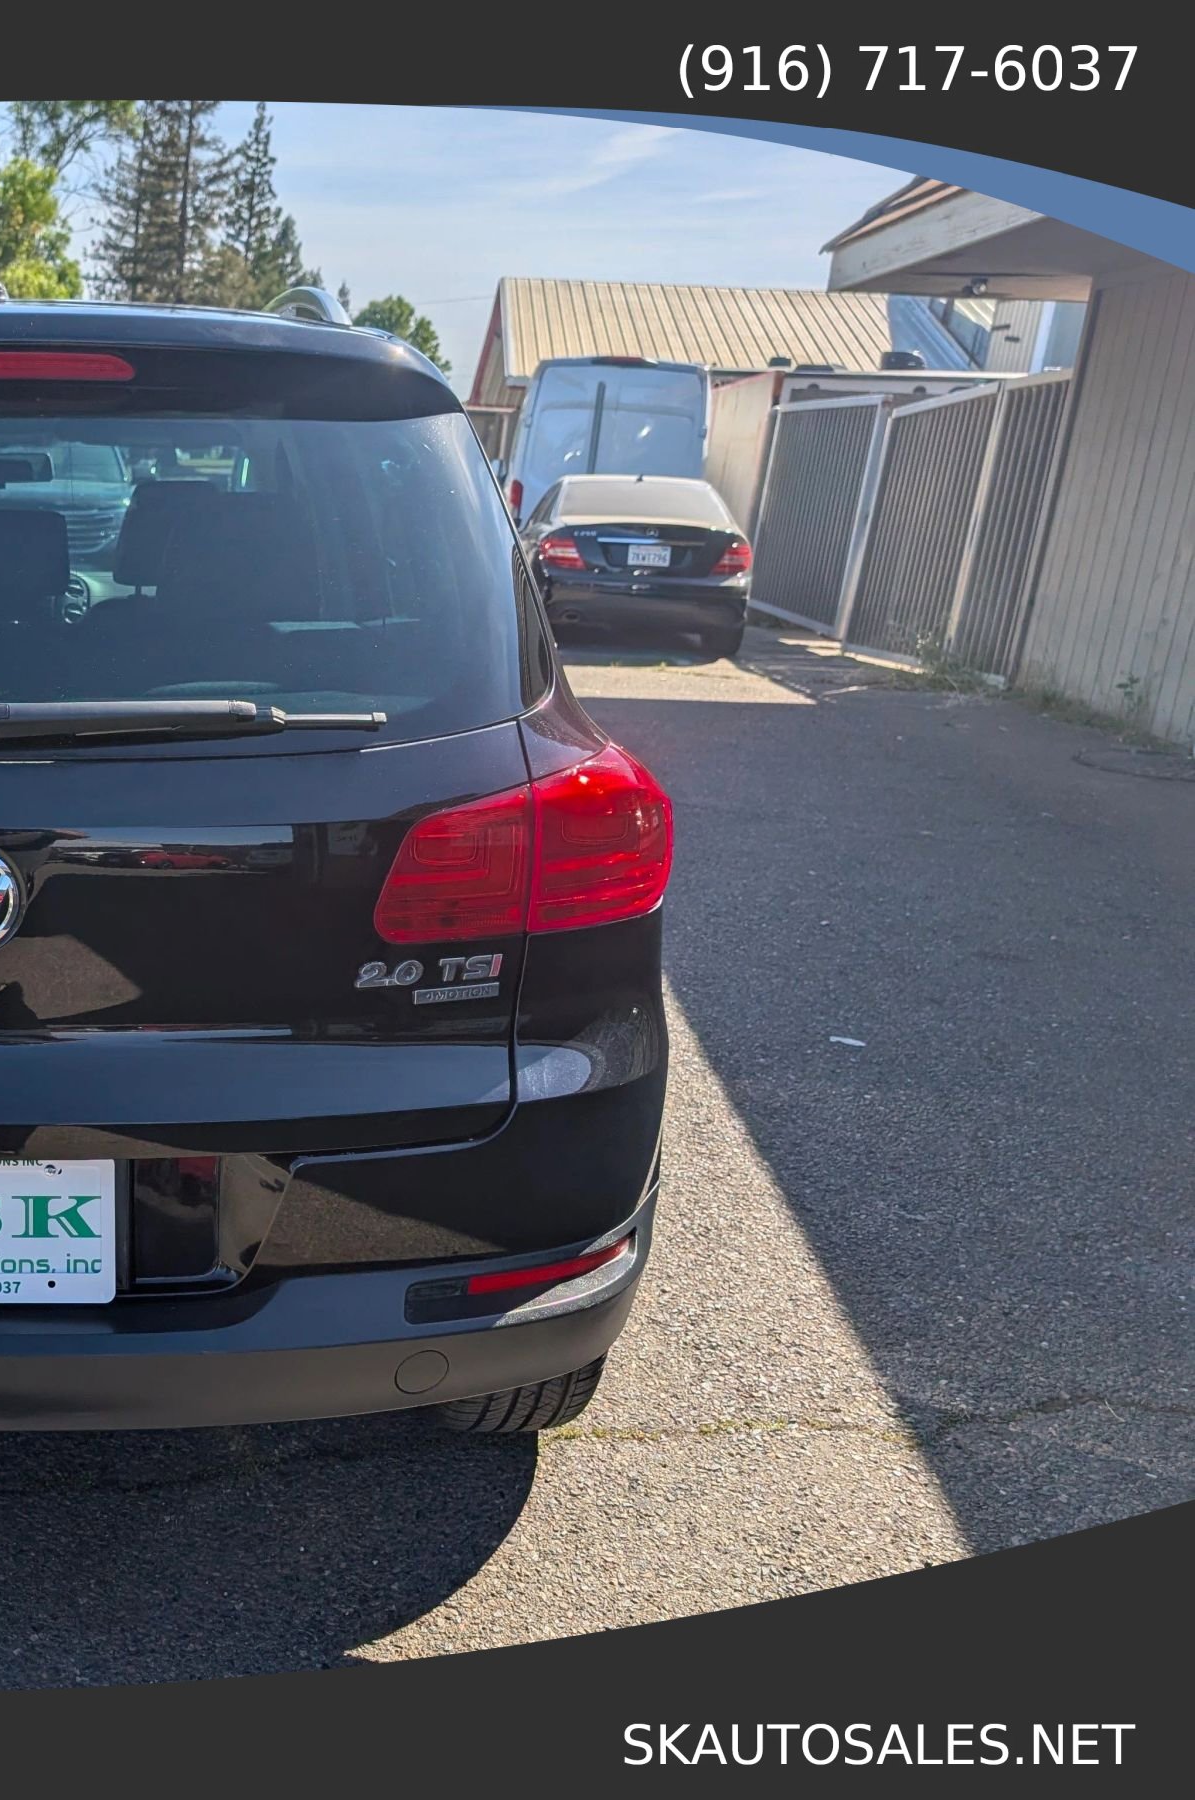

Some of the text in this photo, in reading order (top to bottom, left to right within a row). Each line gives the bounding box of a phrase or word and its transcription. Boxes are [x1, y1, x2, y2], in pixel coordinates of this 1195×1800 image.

[355, 953, 503, 988] 2.0 TSI
[21, 1158, 44, 1168] INC
[65, 1253, 103, 1275] inc
